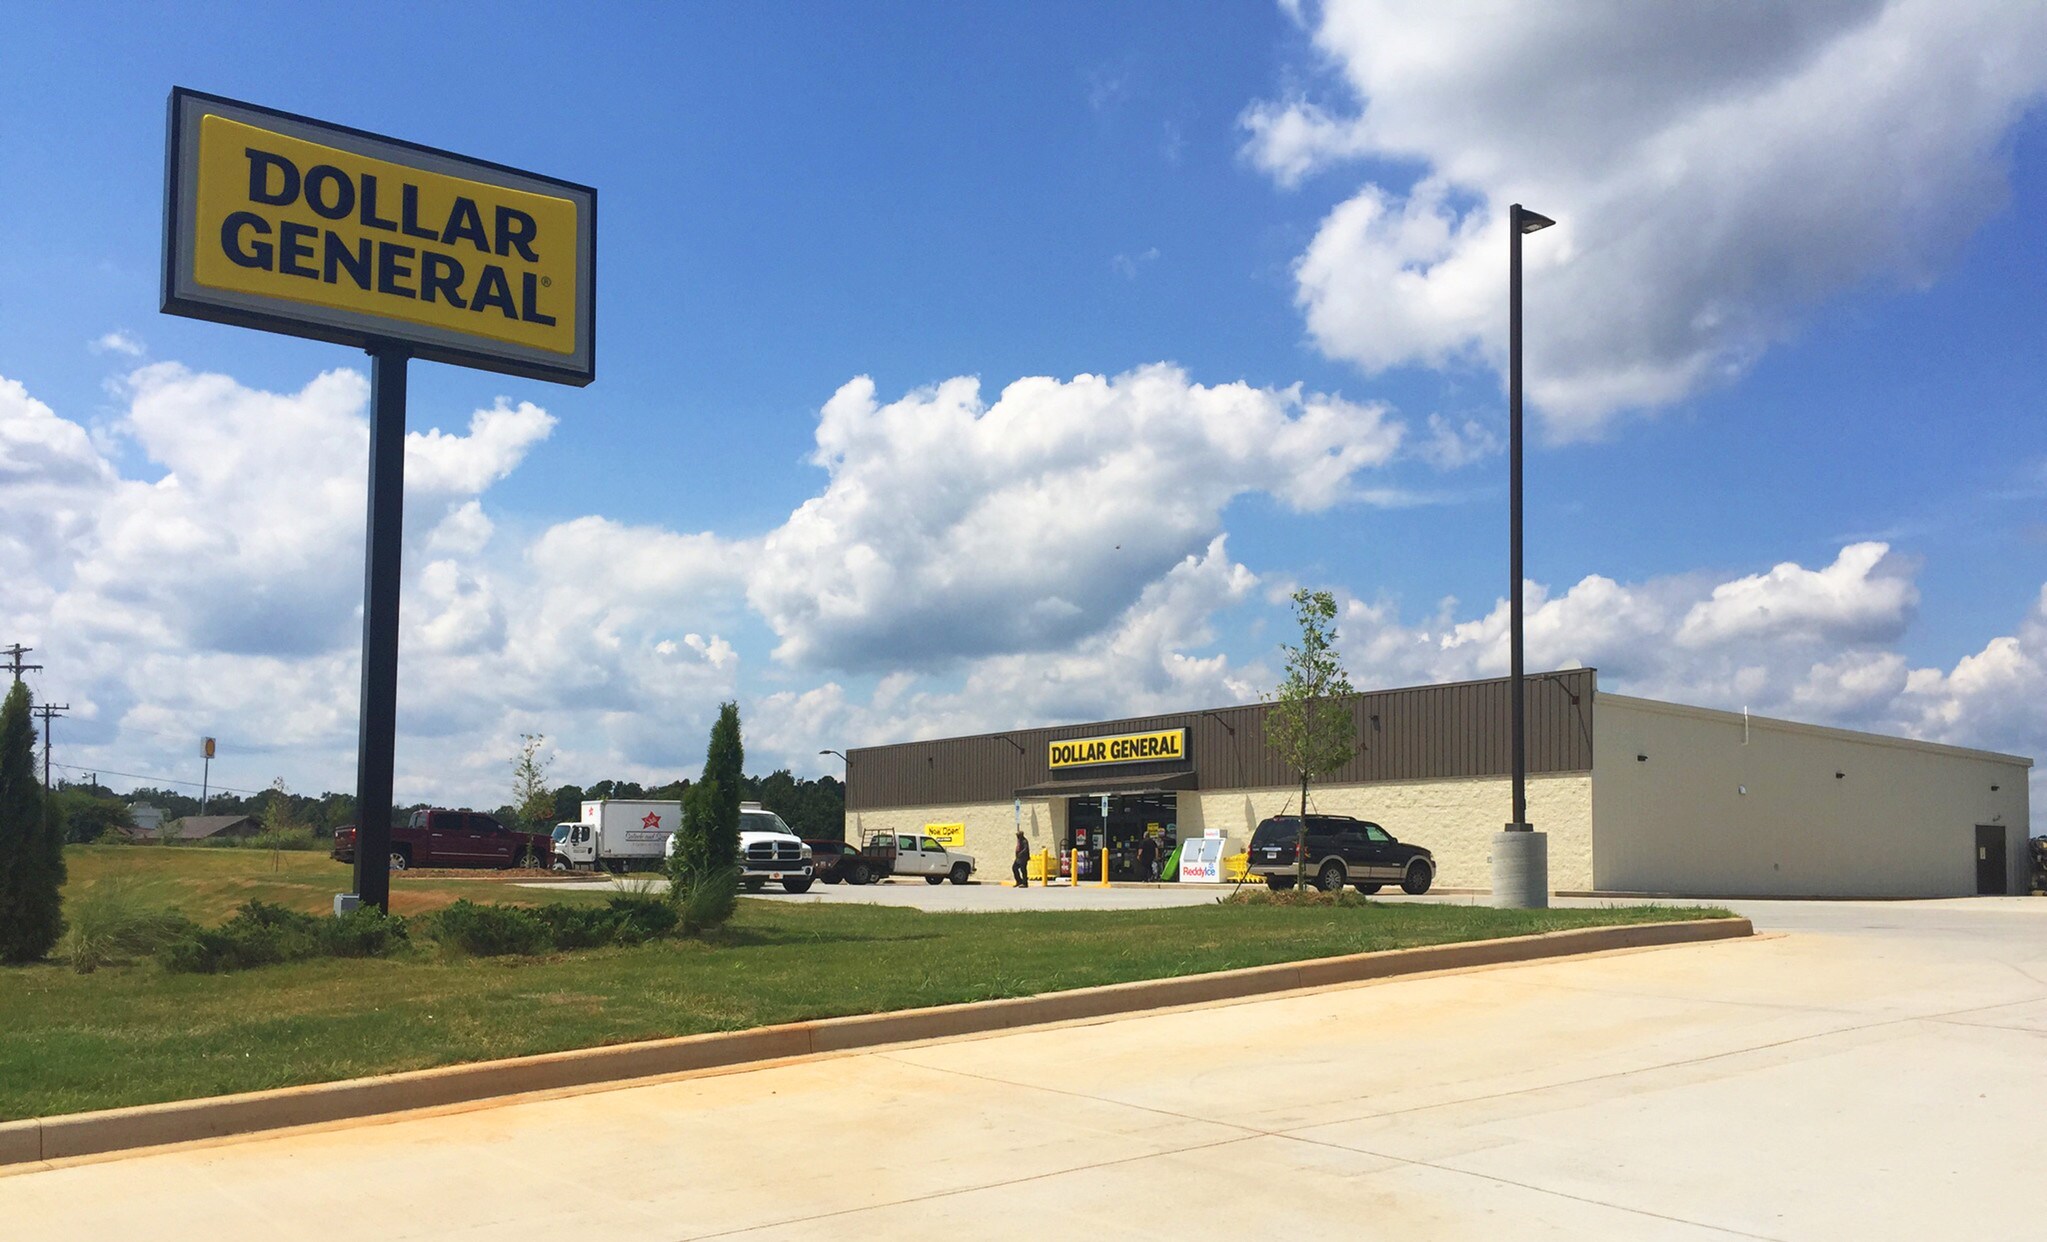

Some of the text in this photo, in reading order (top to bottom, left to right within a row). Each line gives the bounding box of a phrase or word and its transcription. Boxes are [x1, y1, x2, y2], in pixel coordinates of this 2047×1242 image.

[245, 148, 539, 262] DOLLAR
[1052, 735, 1179, 764] DOLLAR GENERAL
